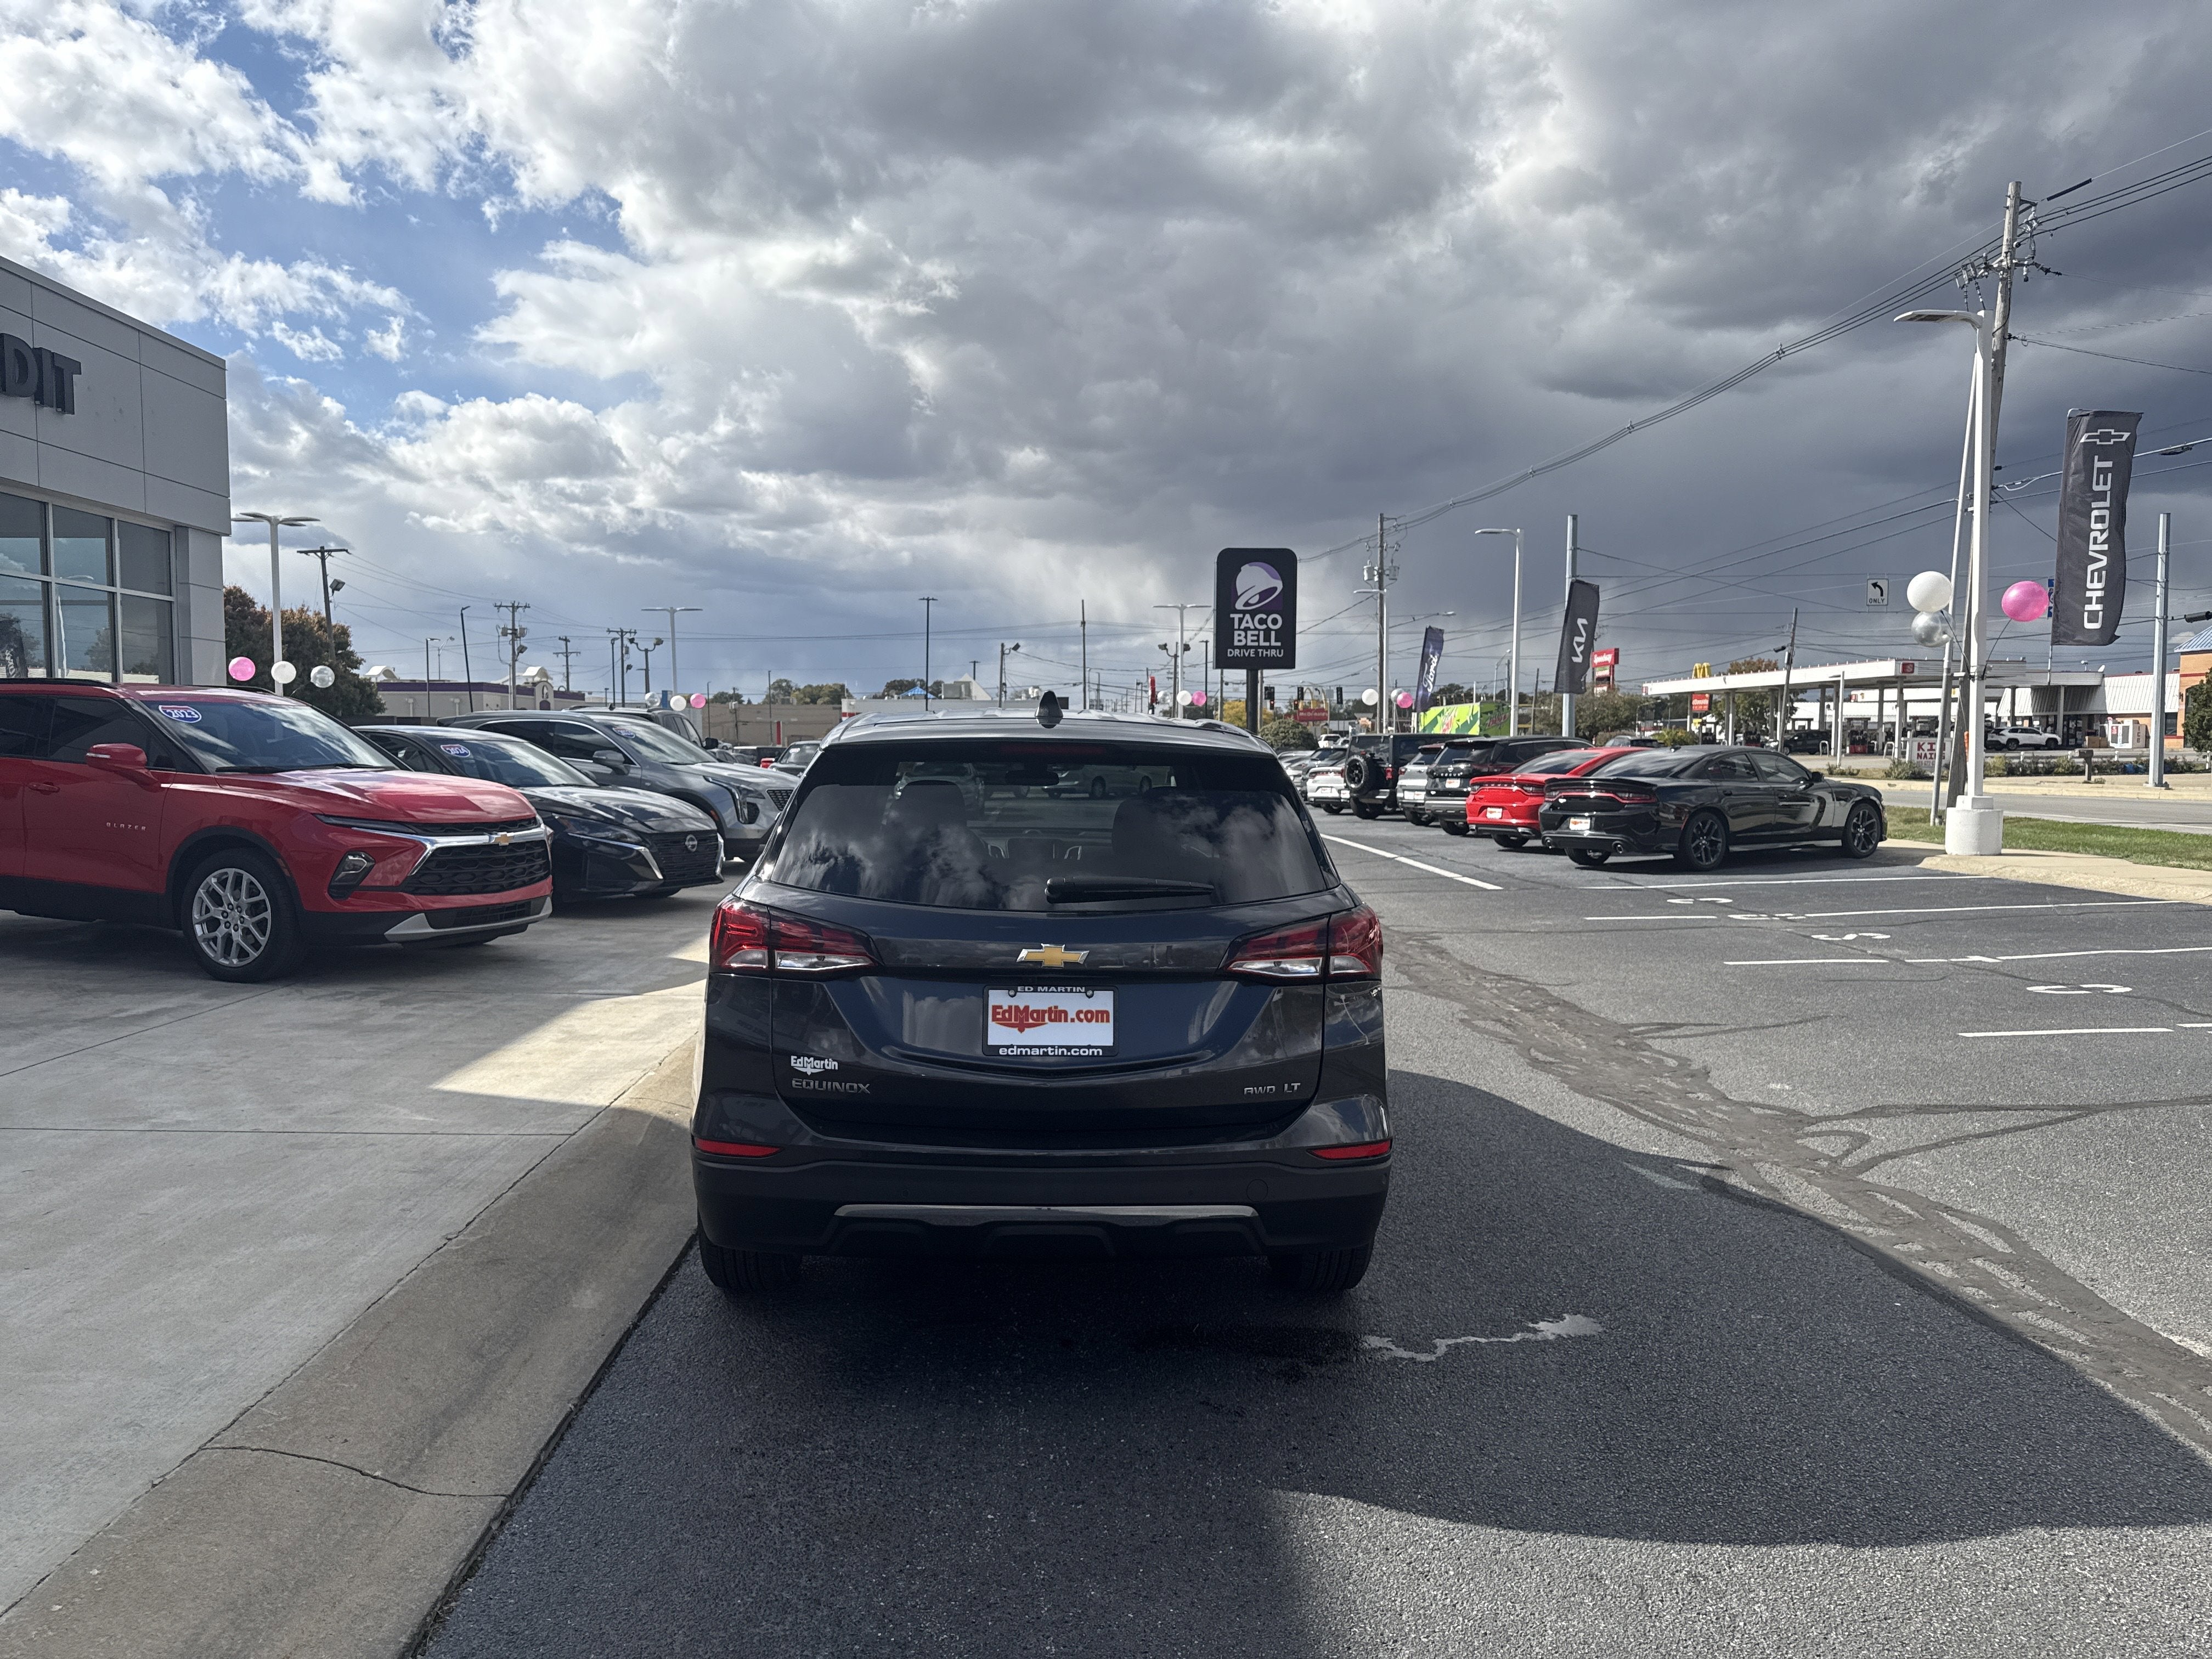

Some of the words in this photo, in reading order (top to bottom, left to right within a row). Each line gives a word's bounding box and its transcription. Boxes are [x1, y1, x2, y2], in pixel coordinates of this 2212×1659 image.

[2084, 455, 2113, 630] CHEVROLET
[1229, 613, 1283, 630] TACO
[1233, 630, 1282, 646] BELL
[1227, 648, 1256, 657] DRIVE
[1257, 648, 1284, 657] THRU
[1423, 653, 1438, 693] Ford
[166, 709, 199, 719] 2023
[106, 822, 146, 831] BLAZER
[991, 1005, 1110, 1025] EdMartin.com
[998, 1045, 1103, 1056] edmartin.com
[790, 1055, 839, 1071] EdMartin
[792, 1077, 871, 1094] EQUINOX
[1244, 1085, 1276, 1096] AWD
[1284, 1082, 1301, 1093] LT
